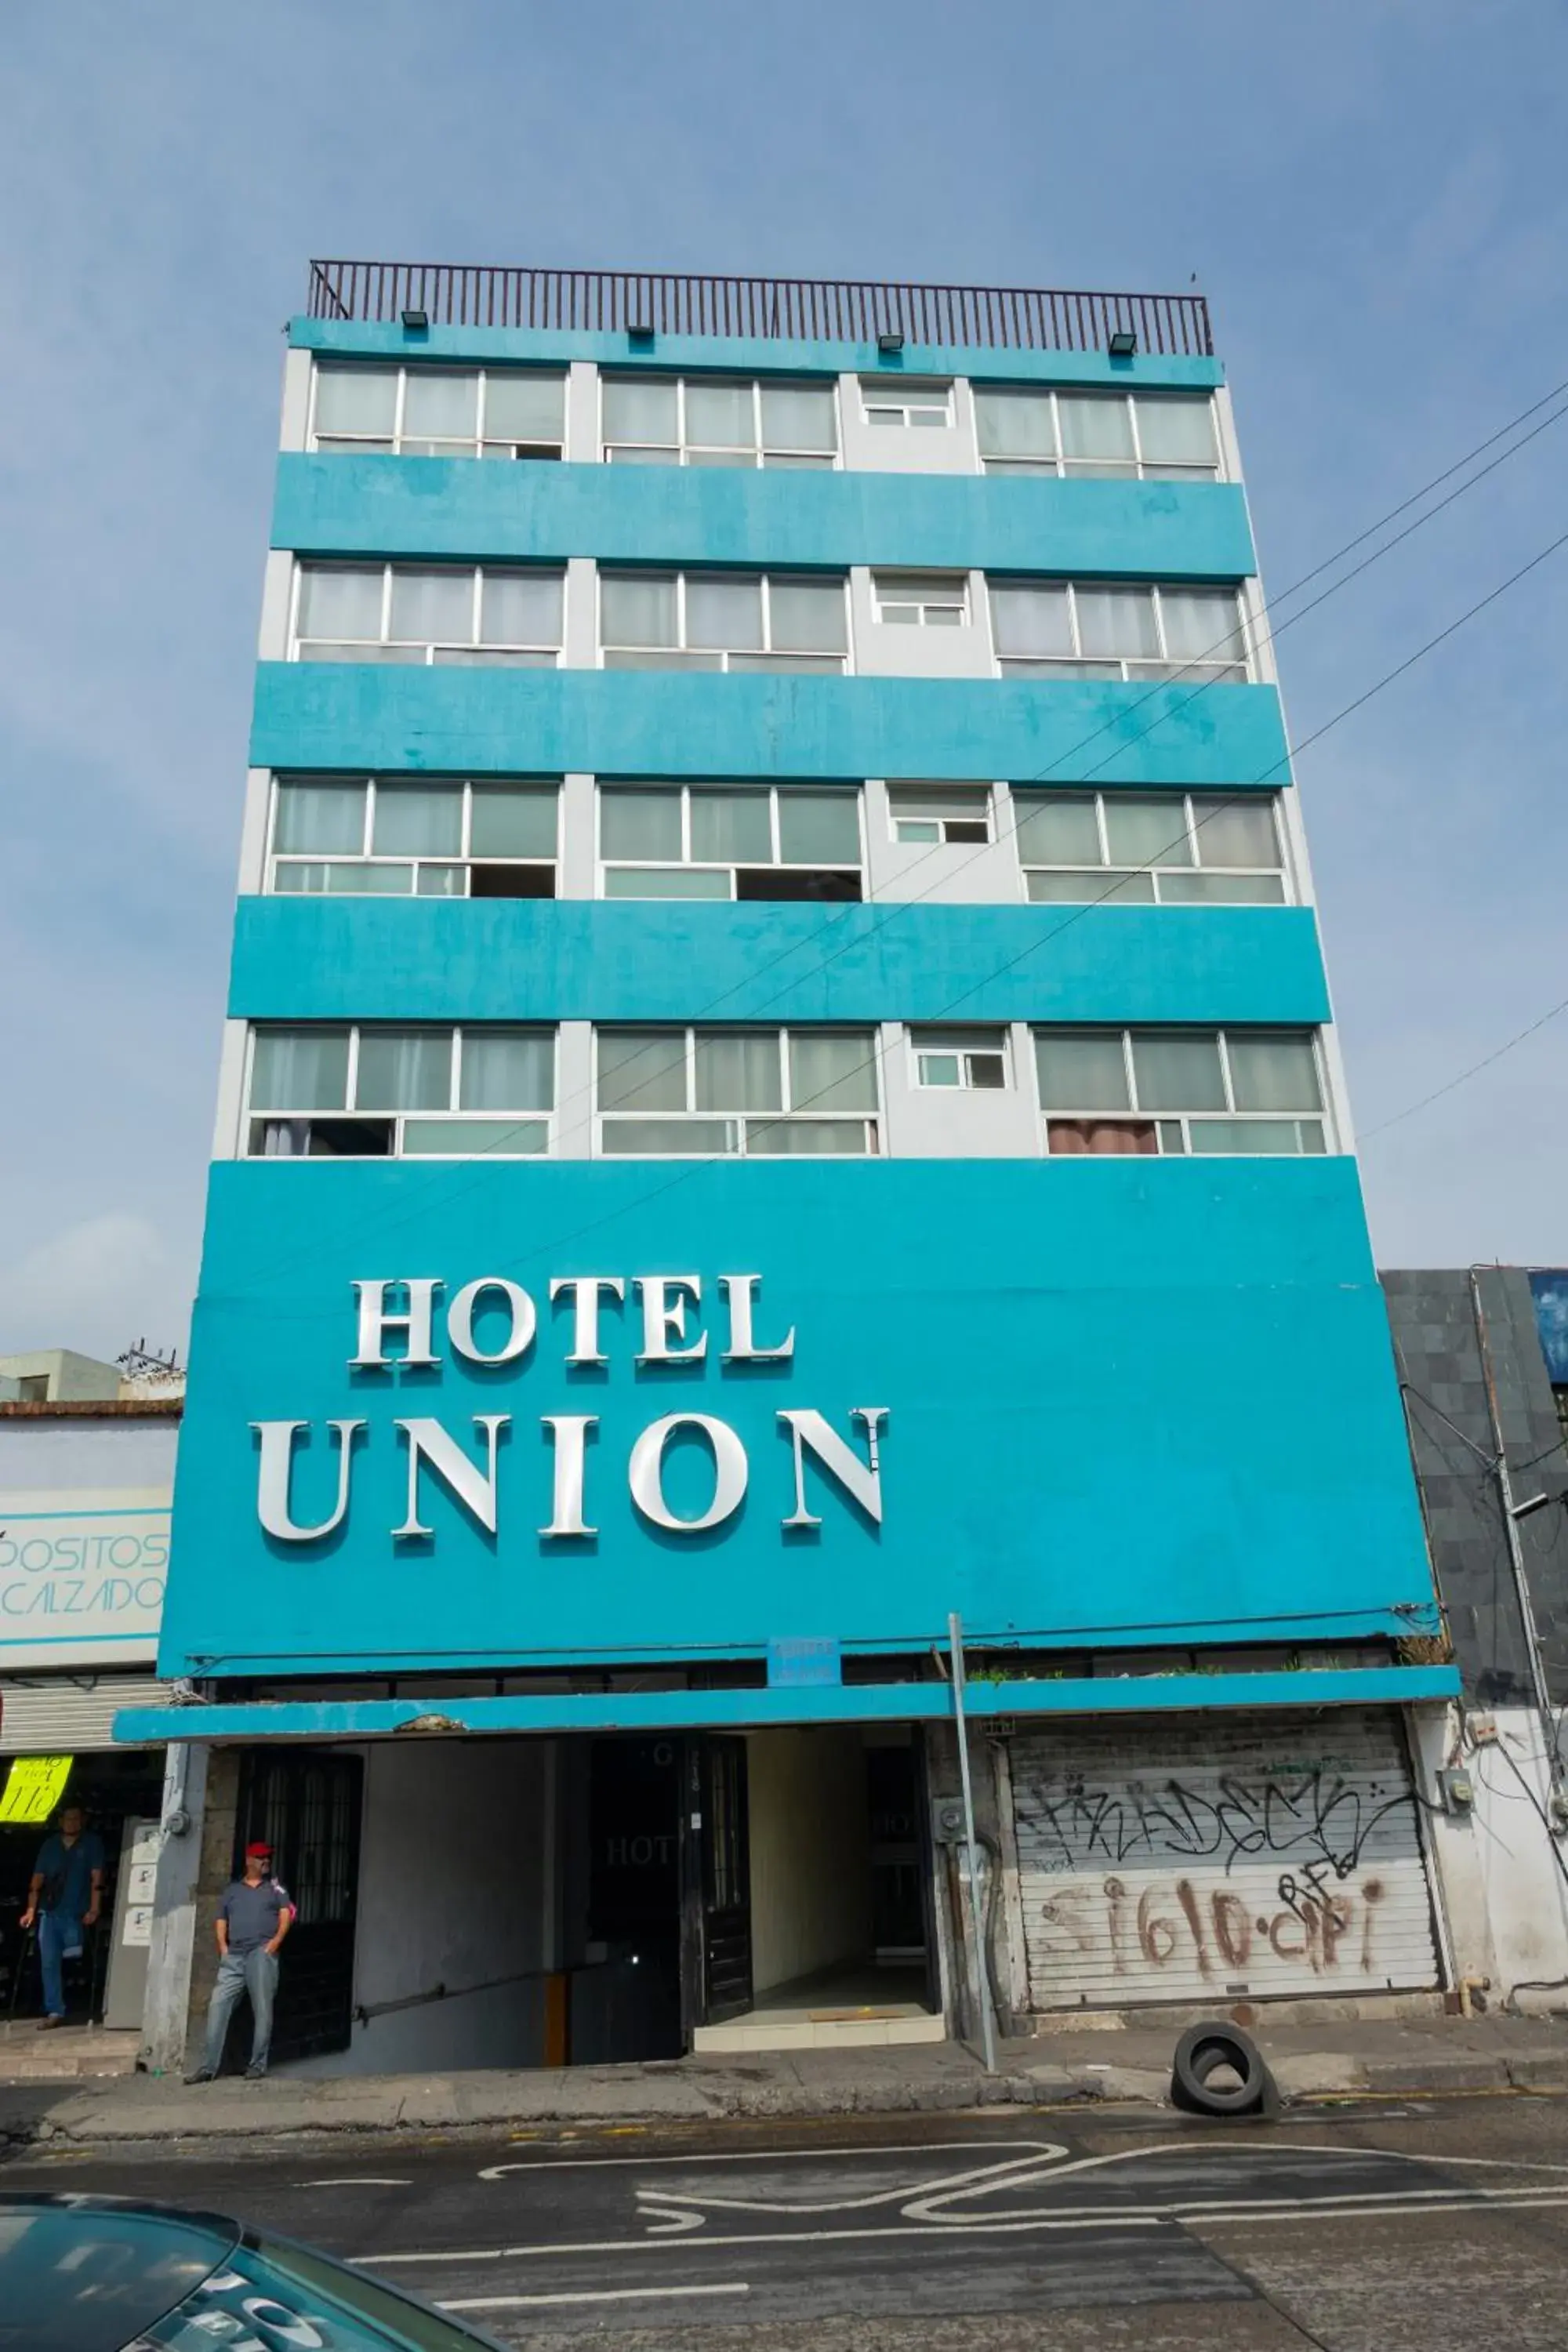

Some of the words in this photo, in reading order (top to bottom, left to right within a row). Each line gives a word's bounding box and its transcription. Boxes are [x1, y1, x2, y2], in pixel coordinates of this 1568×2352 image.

[347, 1274, 796, 1369] HOTEL
[248, 1406, 890, 1541] UNION
[2, 1577, 166, 1616] CALZADO
